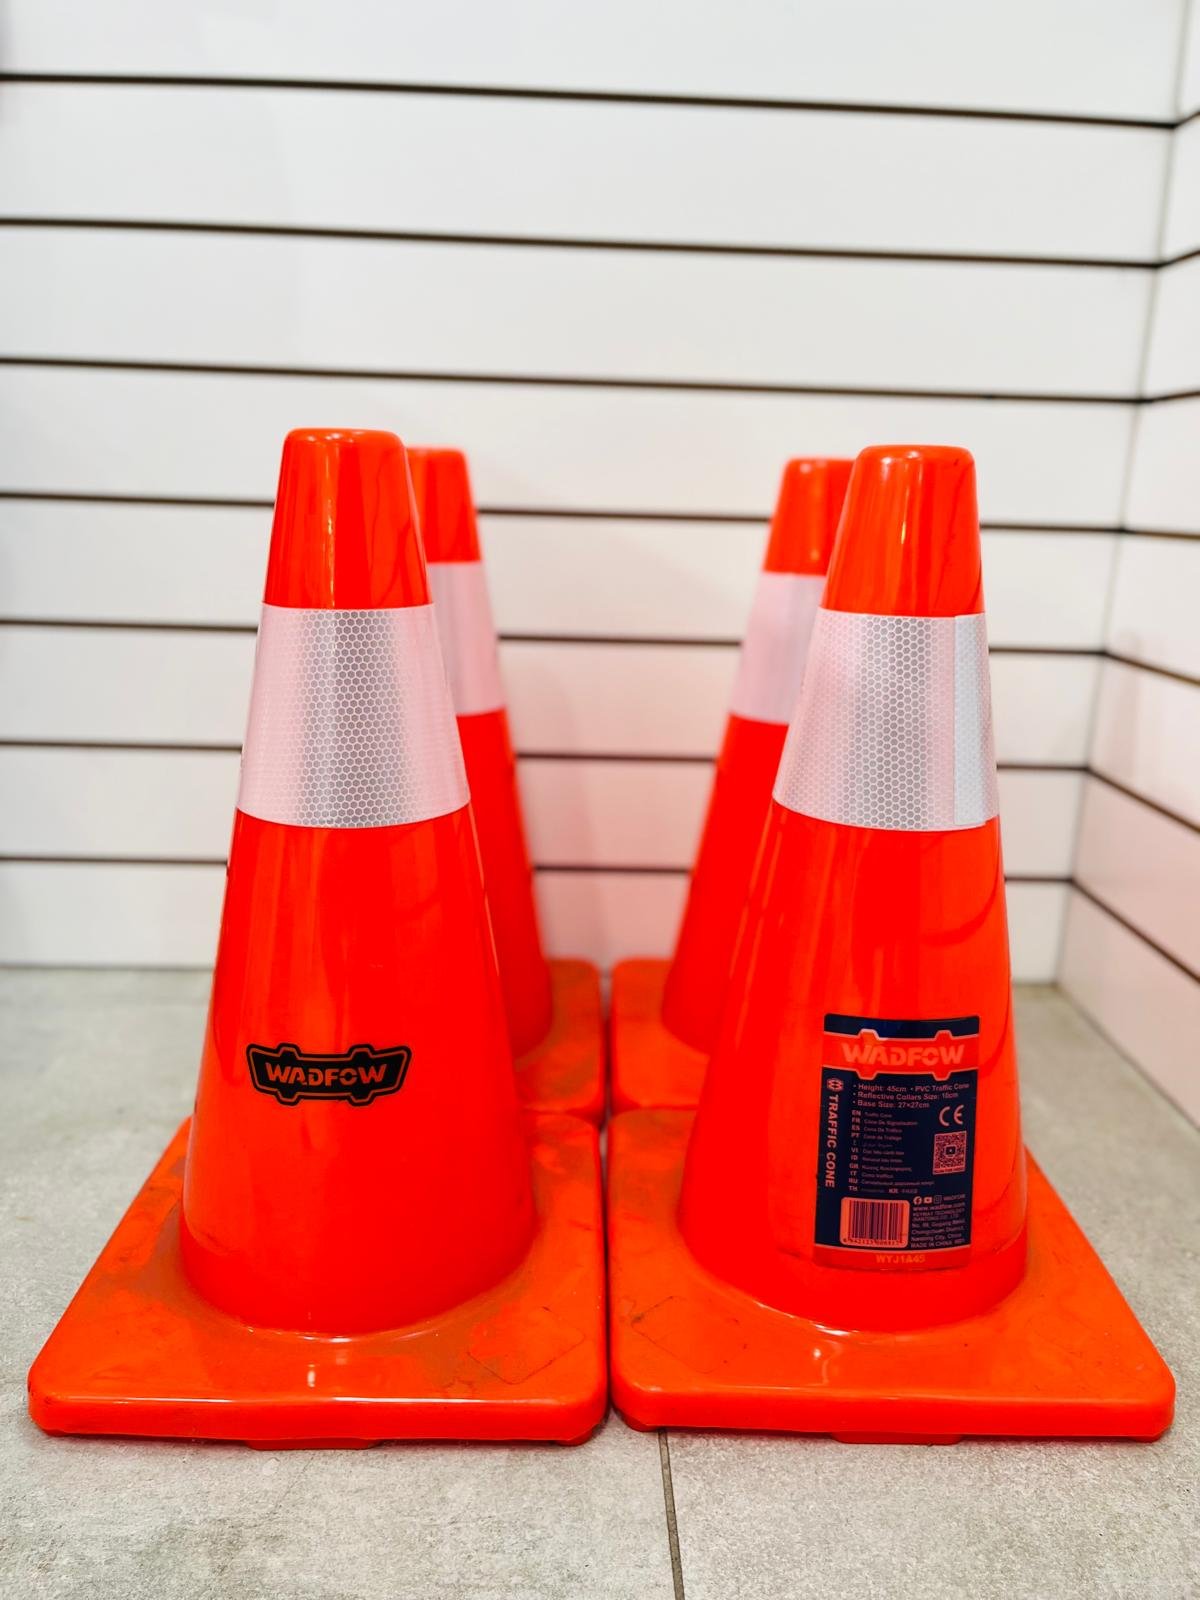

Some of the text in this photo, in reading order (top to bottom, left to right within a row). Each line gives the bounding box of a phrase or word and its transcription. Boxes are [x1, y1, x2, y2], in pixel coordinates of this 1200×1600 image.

[841, 1043, 965, 1066] WADFOW
[265, 1061, 387, 1087] WADFOW
[858, 1084, 884, 1093] Height:
[887, 1085, 907, 1093] 45cm
[915, 1084, 931, 1093] PVC
[933, 1083, 953, 1092] Traffic
[858, 1091, 894, 1100] Reflective
[896, 1093, 923, 1101] Collars
[858, 1099, 876, 1108] Base
[825, 1094, 839, 1188] TRAFFIC CONE
